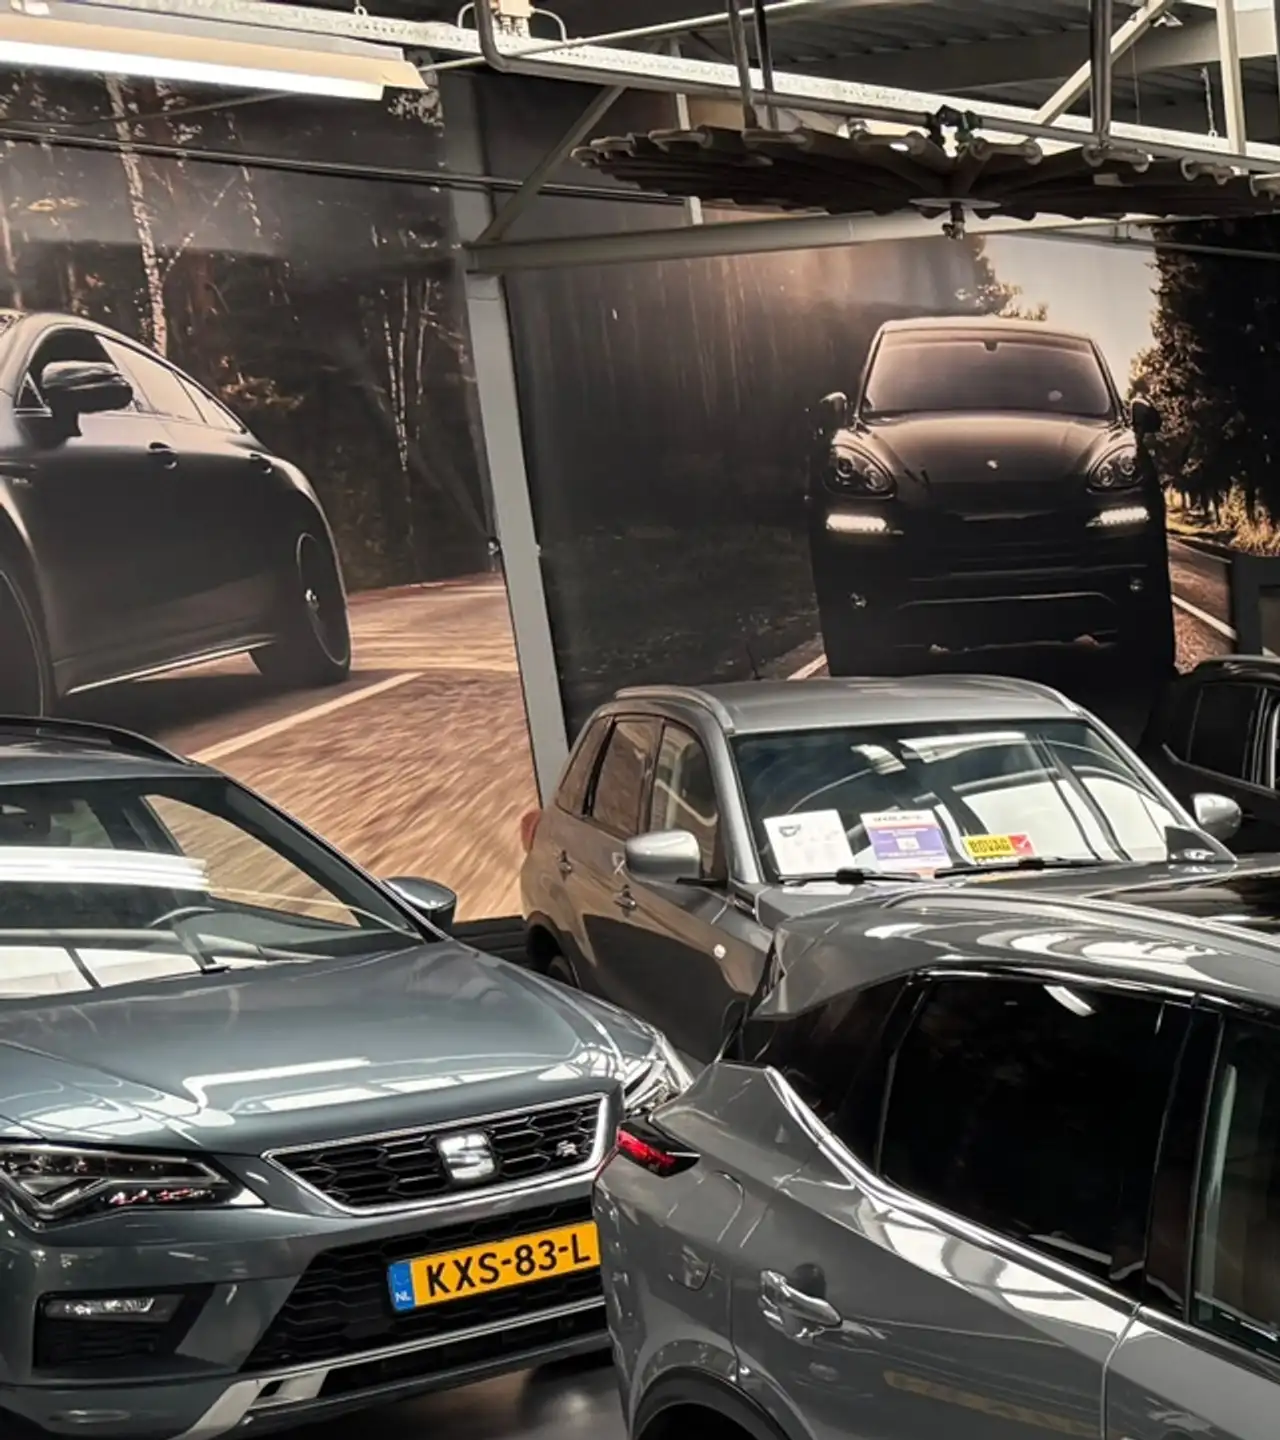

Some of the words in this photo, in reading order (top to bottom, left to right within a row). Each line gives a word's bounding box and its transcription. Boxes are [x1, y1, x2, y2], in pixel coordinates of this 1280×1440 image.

[967, 837, 1012, 853] BOVAG
[426, 1233, 590, 1297] KXS-83-L
[394, 1291, 411, 1302] NL
